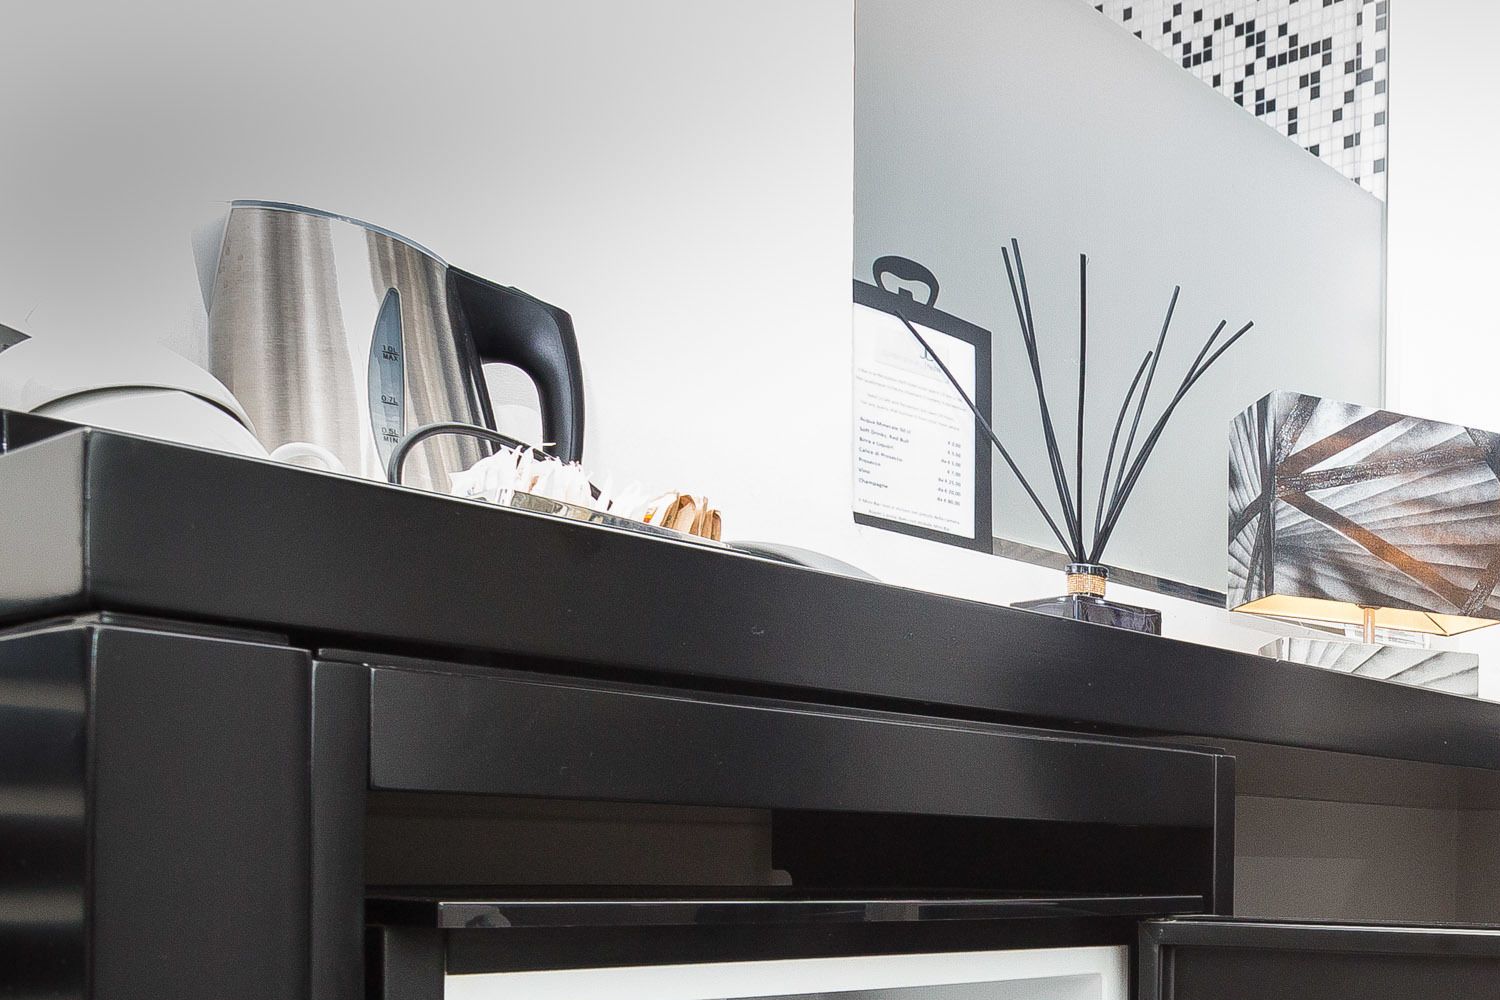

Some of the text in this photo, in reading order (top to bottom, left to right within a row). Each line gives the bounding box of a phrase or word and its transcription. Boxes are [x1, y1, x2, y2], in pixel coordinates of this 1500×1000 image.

[382, 353, 399, 362] MAX
[381, 394, 398, 403] 0.7L
[383, 435, 399, 444] MIN
